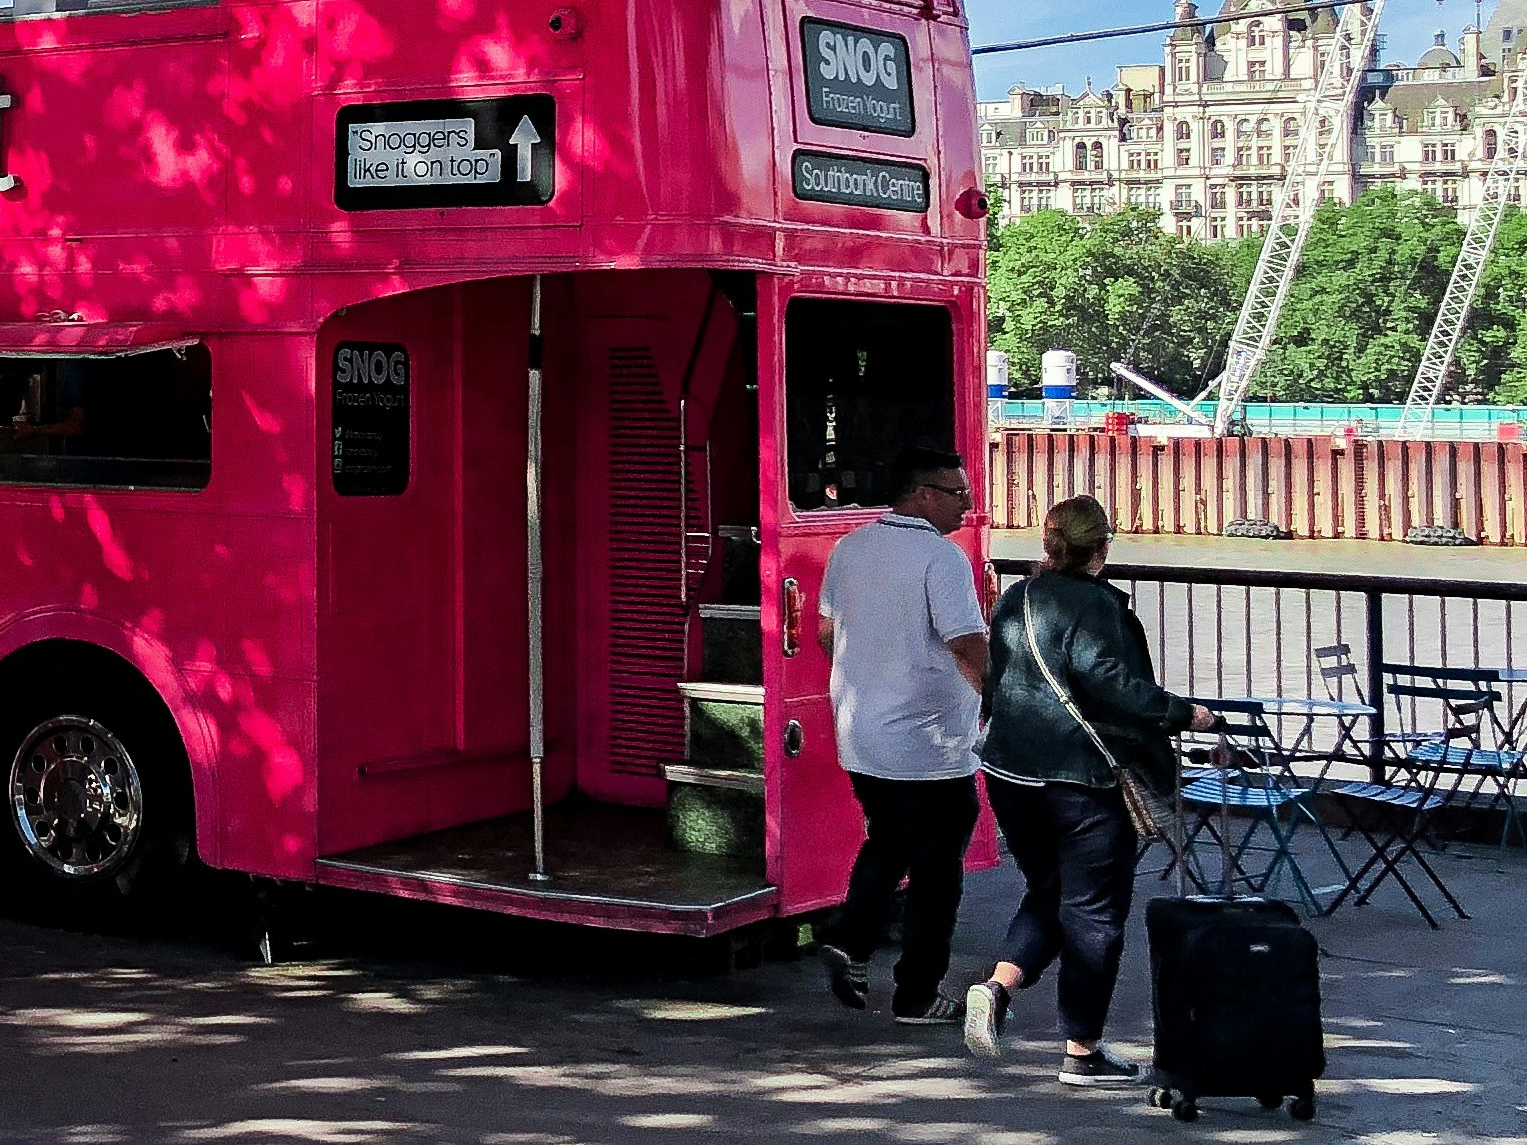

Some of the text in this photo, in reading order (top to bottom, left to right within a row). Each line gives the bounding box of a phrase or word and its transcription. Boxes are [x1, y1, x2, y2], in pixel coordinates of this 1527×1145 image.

[818, 30, 898, 90] SNOG
[822, 87, 902, 123] Frozen Yogurt
[353, 158, 390, 180] like
[395, 157, 408, 179] it
[413, 158, 443, 178] on
[801, 161, 923, 203] Southbank Centre
[336, 348, 405, 385] SNOG
[336, 389, 405, 410] Frozen Yogurt
